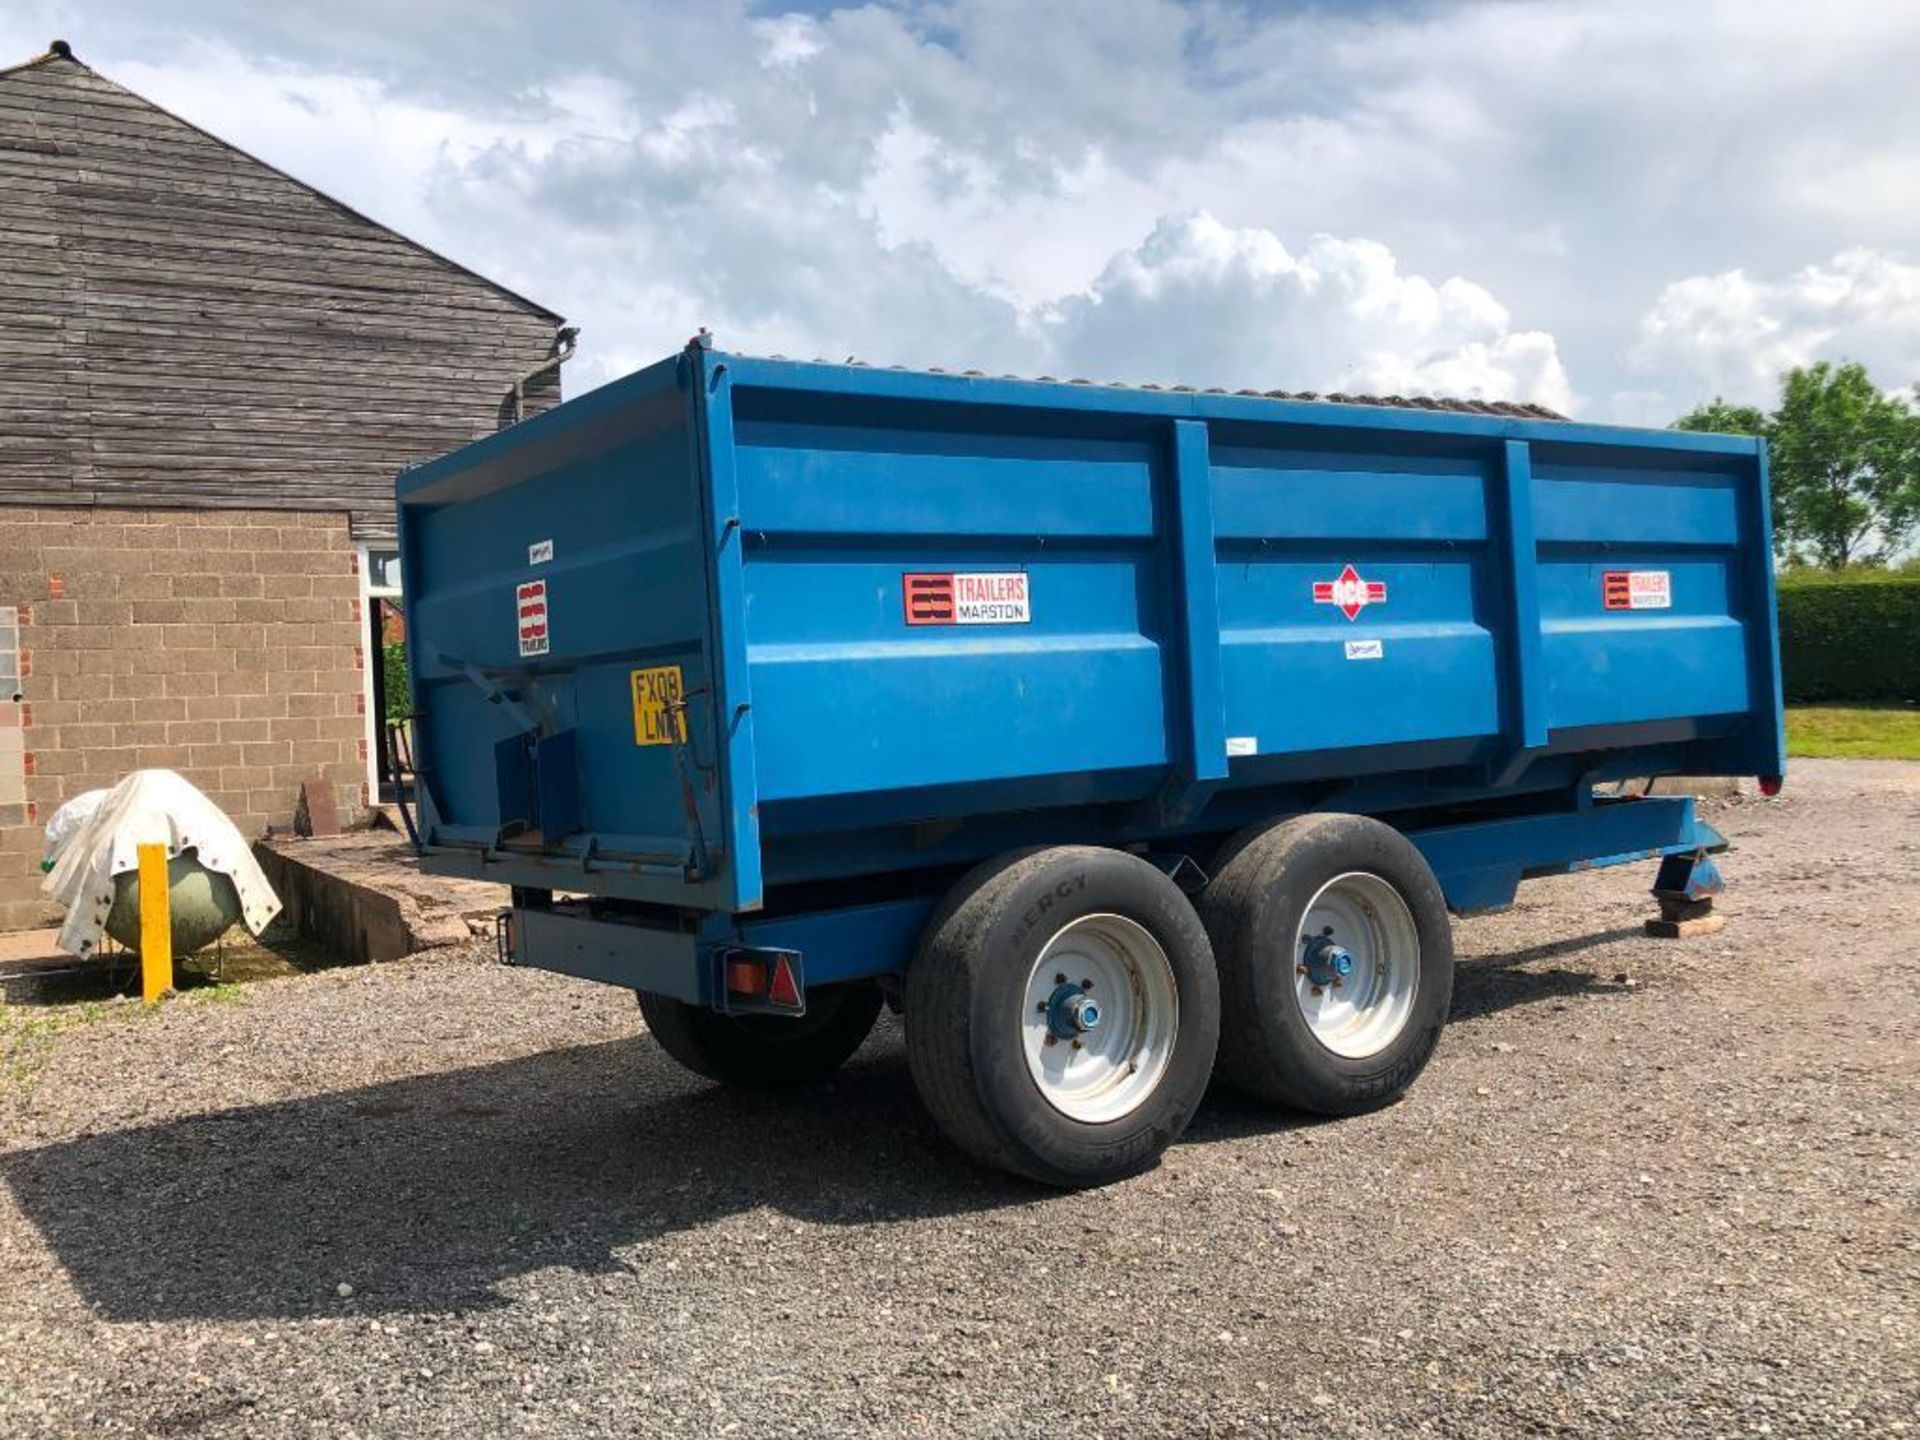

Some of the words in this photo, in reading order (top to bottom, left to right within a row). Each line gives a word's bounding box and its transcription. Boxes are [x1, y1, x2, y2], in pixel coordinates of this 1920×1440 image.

[957, 577, 1024, 602] TRAILERS
[958, 604, 1024, 619] MARSTON
[636, 671, 680, 705] FX08
